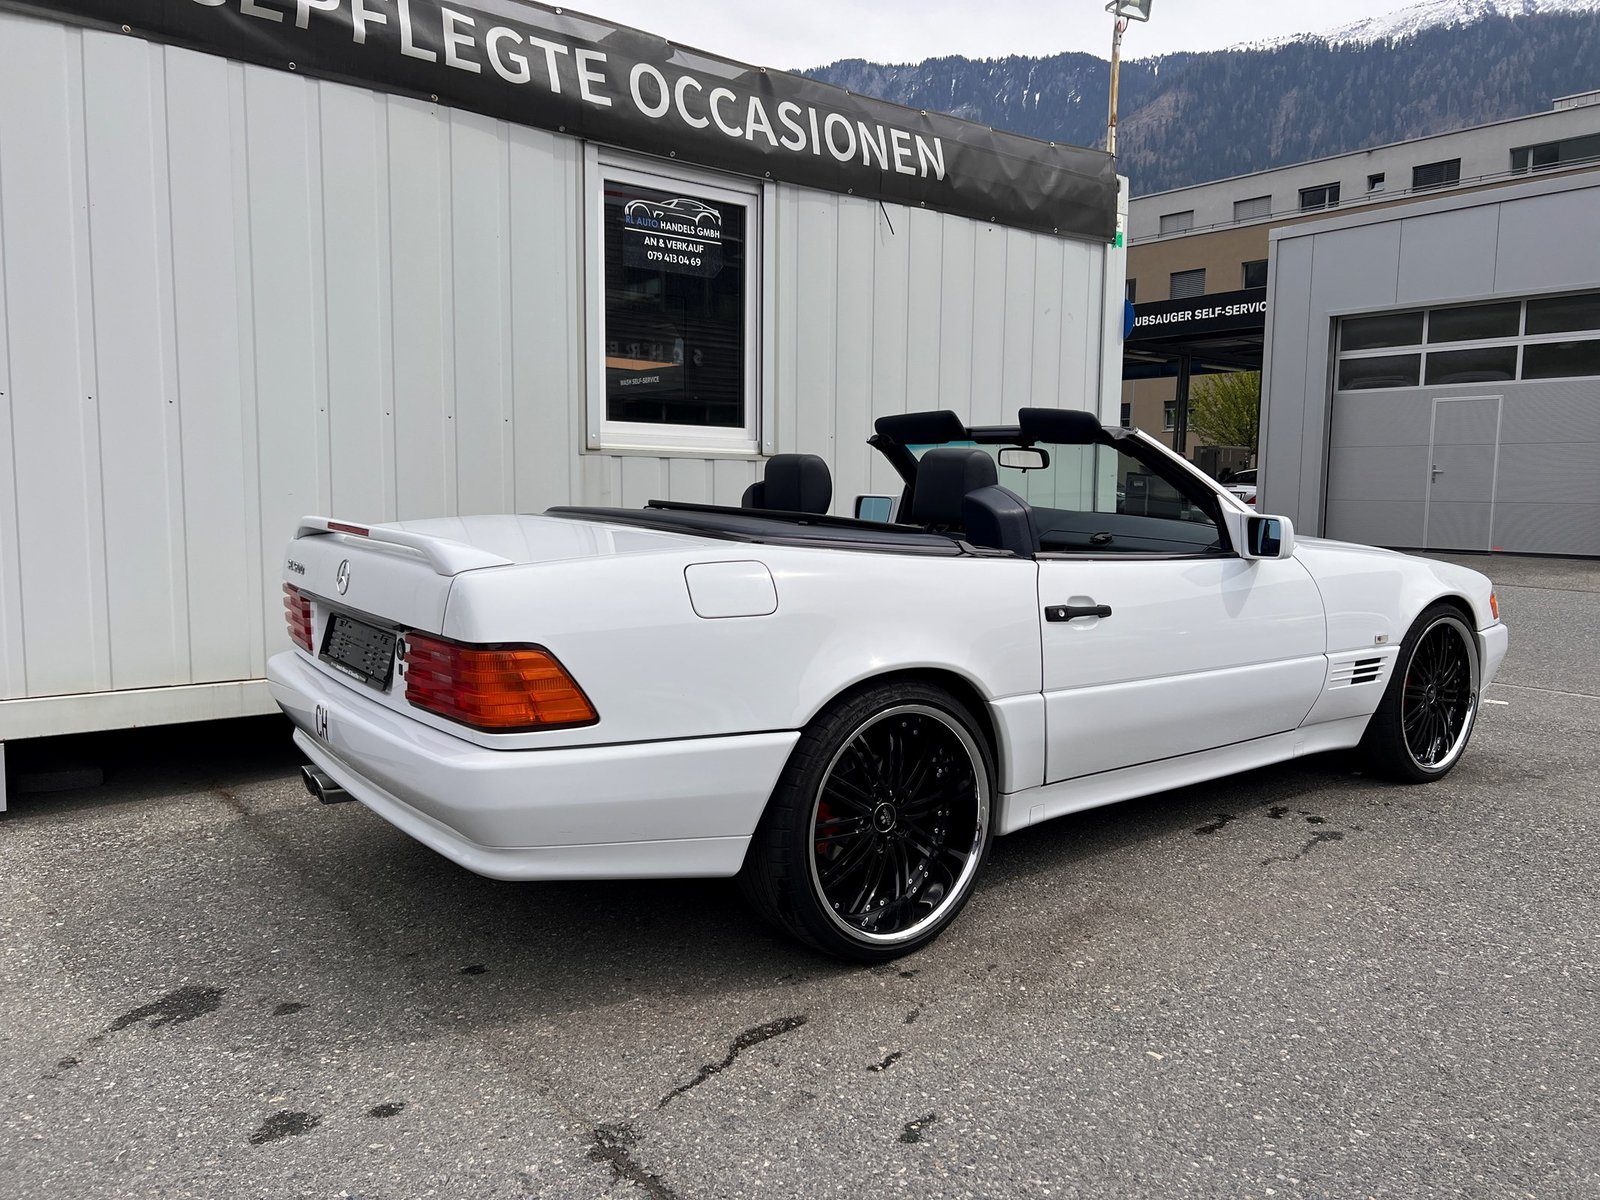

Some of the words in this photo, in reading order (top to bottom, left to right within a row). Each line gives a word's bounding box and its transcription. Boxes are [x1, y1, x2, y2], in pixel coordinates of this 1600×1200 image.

[629, 63, 945, 181] OCCASIONEN
[636, 218, 658, 228] AUTO
[660, 221, 695, 234] HANDELS
[696, 228, 720, 239] GMBH
[644, 236, 657, 247] AN
[658, 239, 665, 248] &
[666, 241, 704, 253] VERKAUF
[647, 251, 663, 261] 079
[664, 254, 677, 263] 413
[678, 256, 689, 265] 04
[690, 258, 701, 267] 69
[1132, 311, 1192, 327] UBSAUGER
[315, 704, 330, 743] CH
